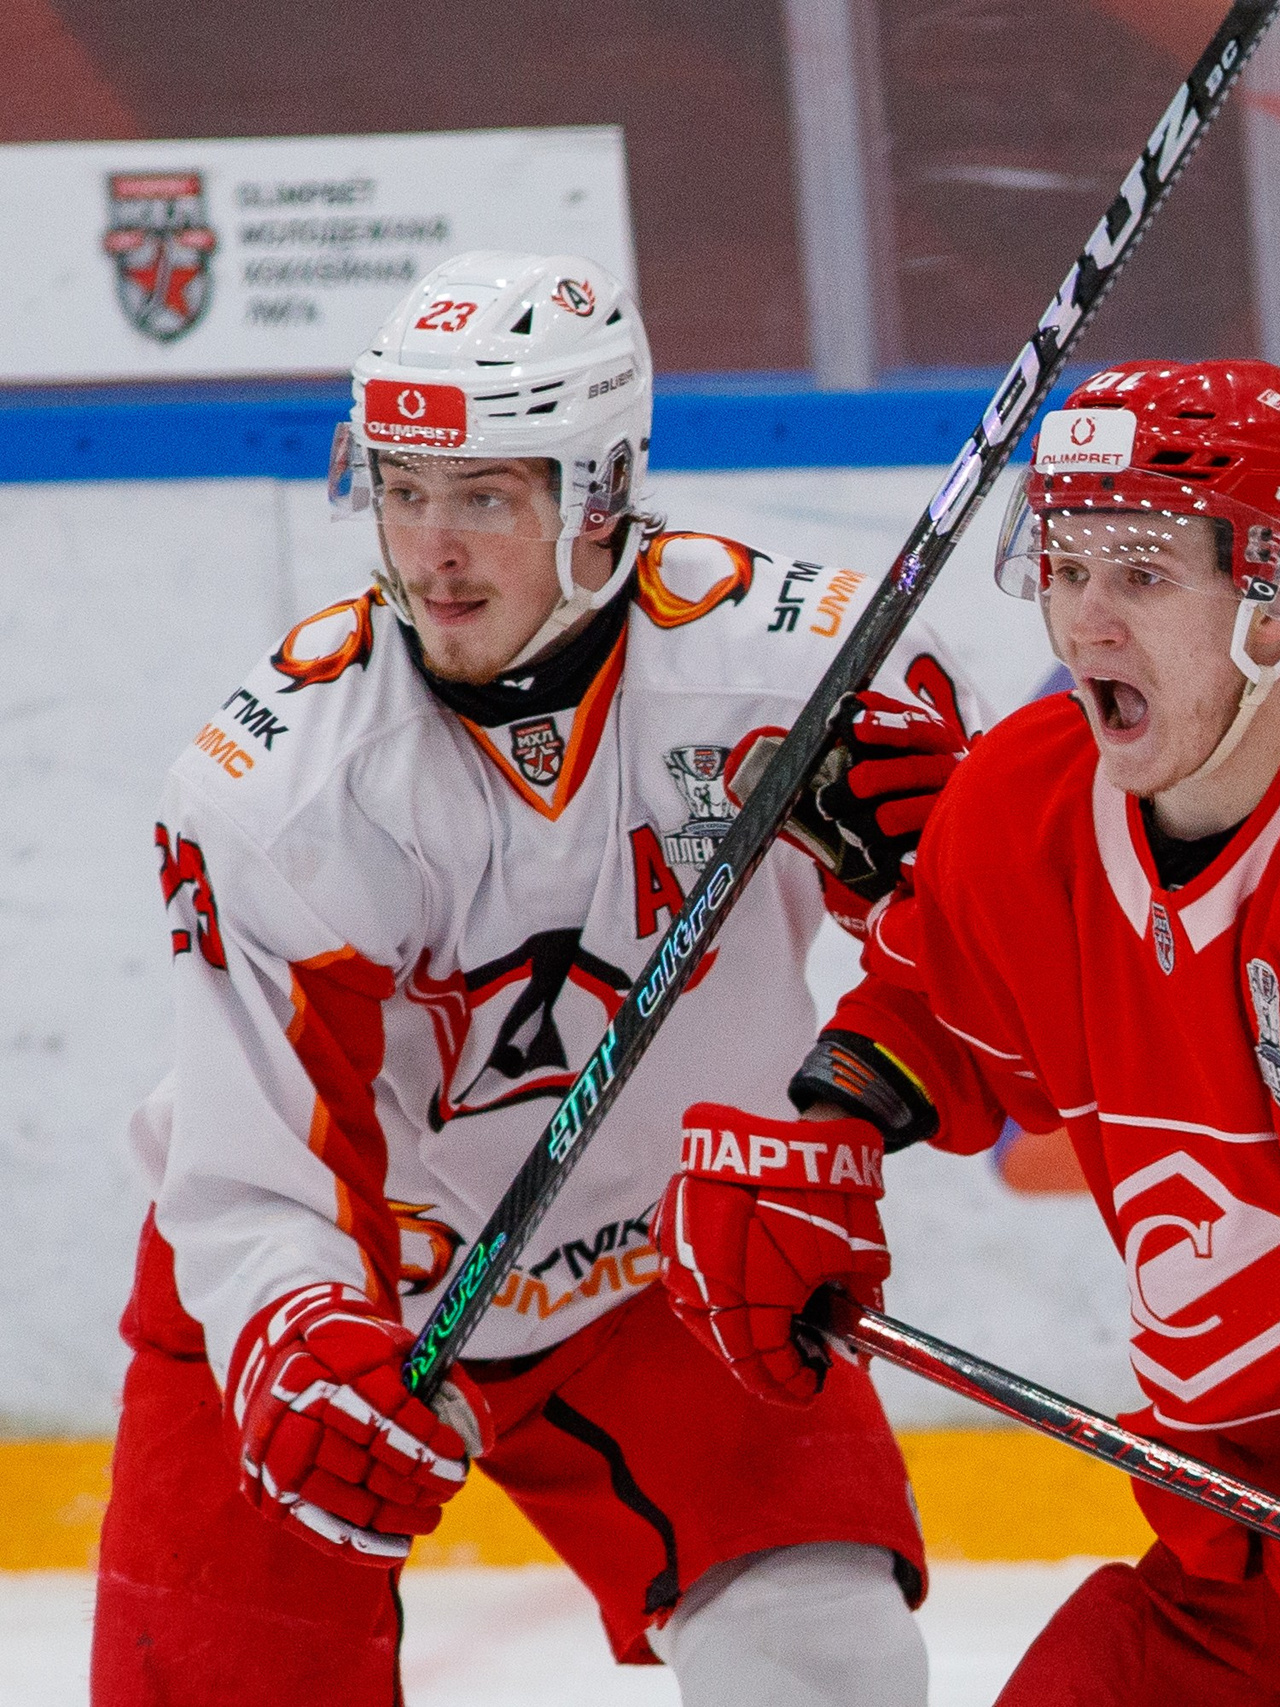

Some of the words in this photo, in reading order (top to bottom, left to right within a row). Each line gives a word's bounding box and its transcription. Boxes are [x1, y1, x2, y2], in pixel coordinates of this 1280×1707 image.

[414, 300, 478, 332] 23
[588, 368, 634, 399] BAUER
[367, 422, 459, 441] OLIMPBET
[766, 559, 825, 633] УГМ
[808, 568, 868, 638] UMM
[222, 686, 289, 751] ГМК
[637, 862, 735, 1019] ultra
